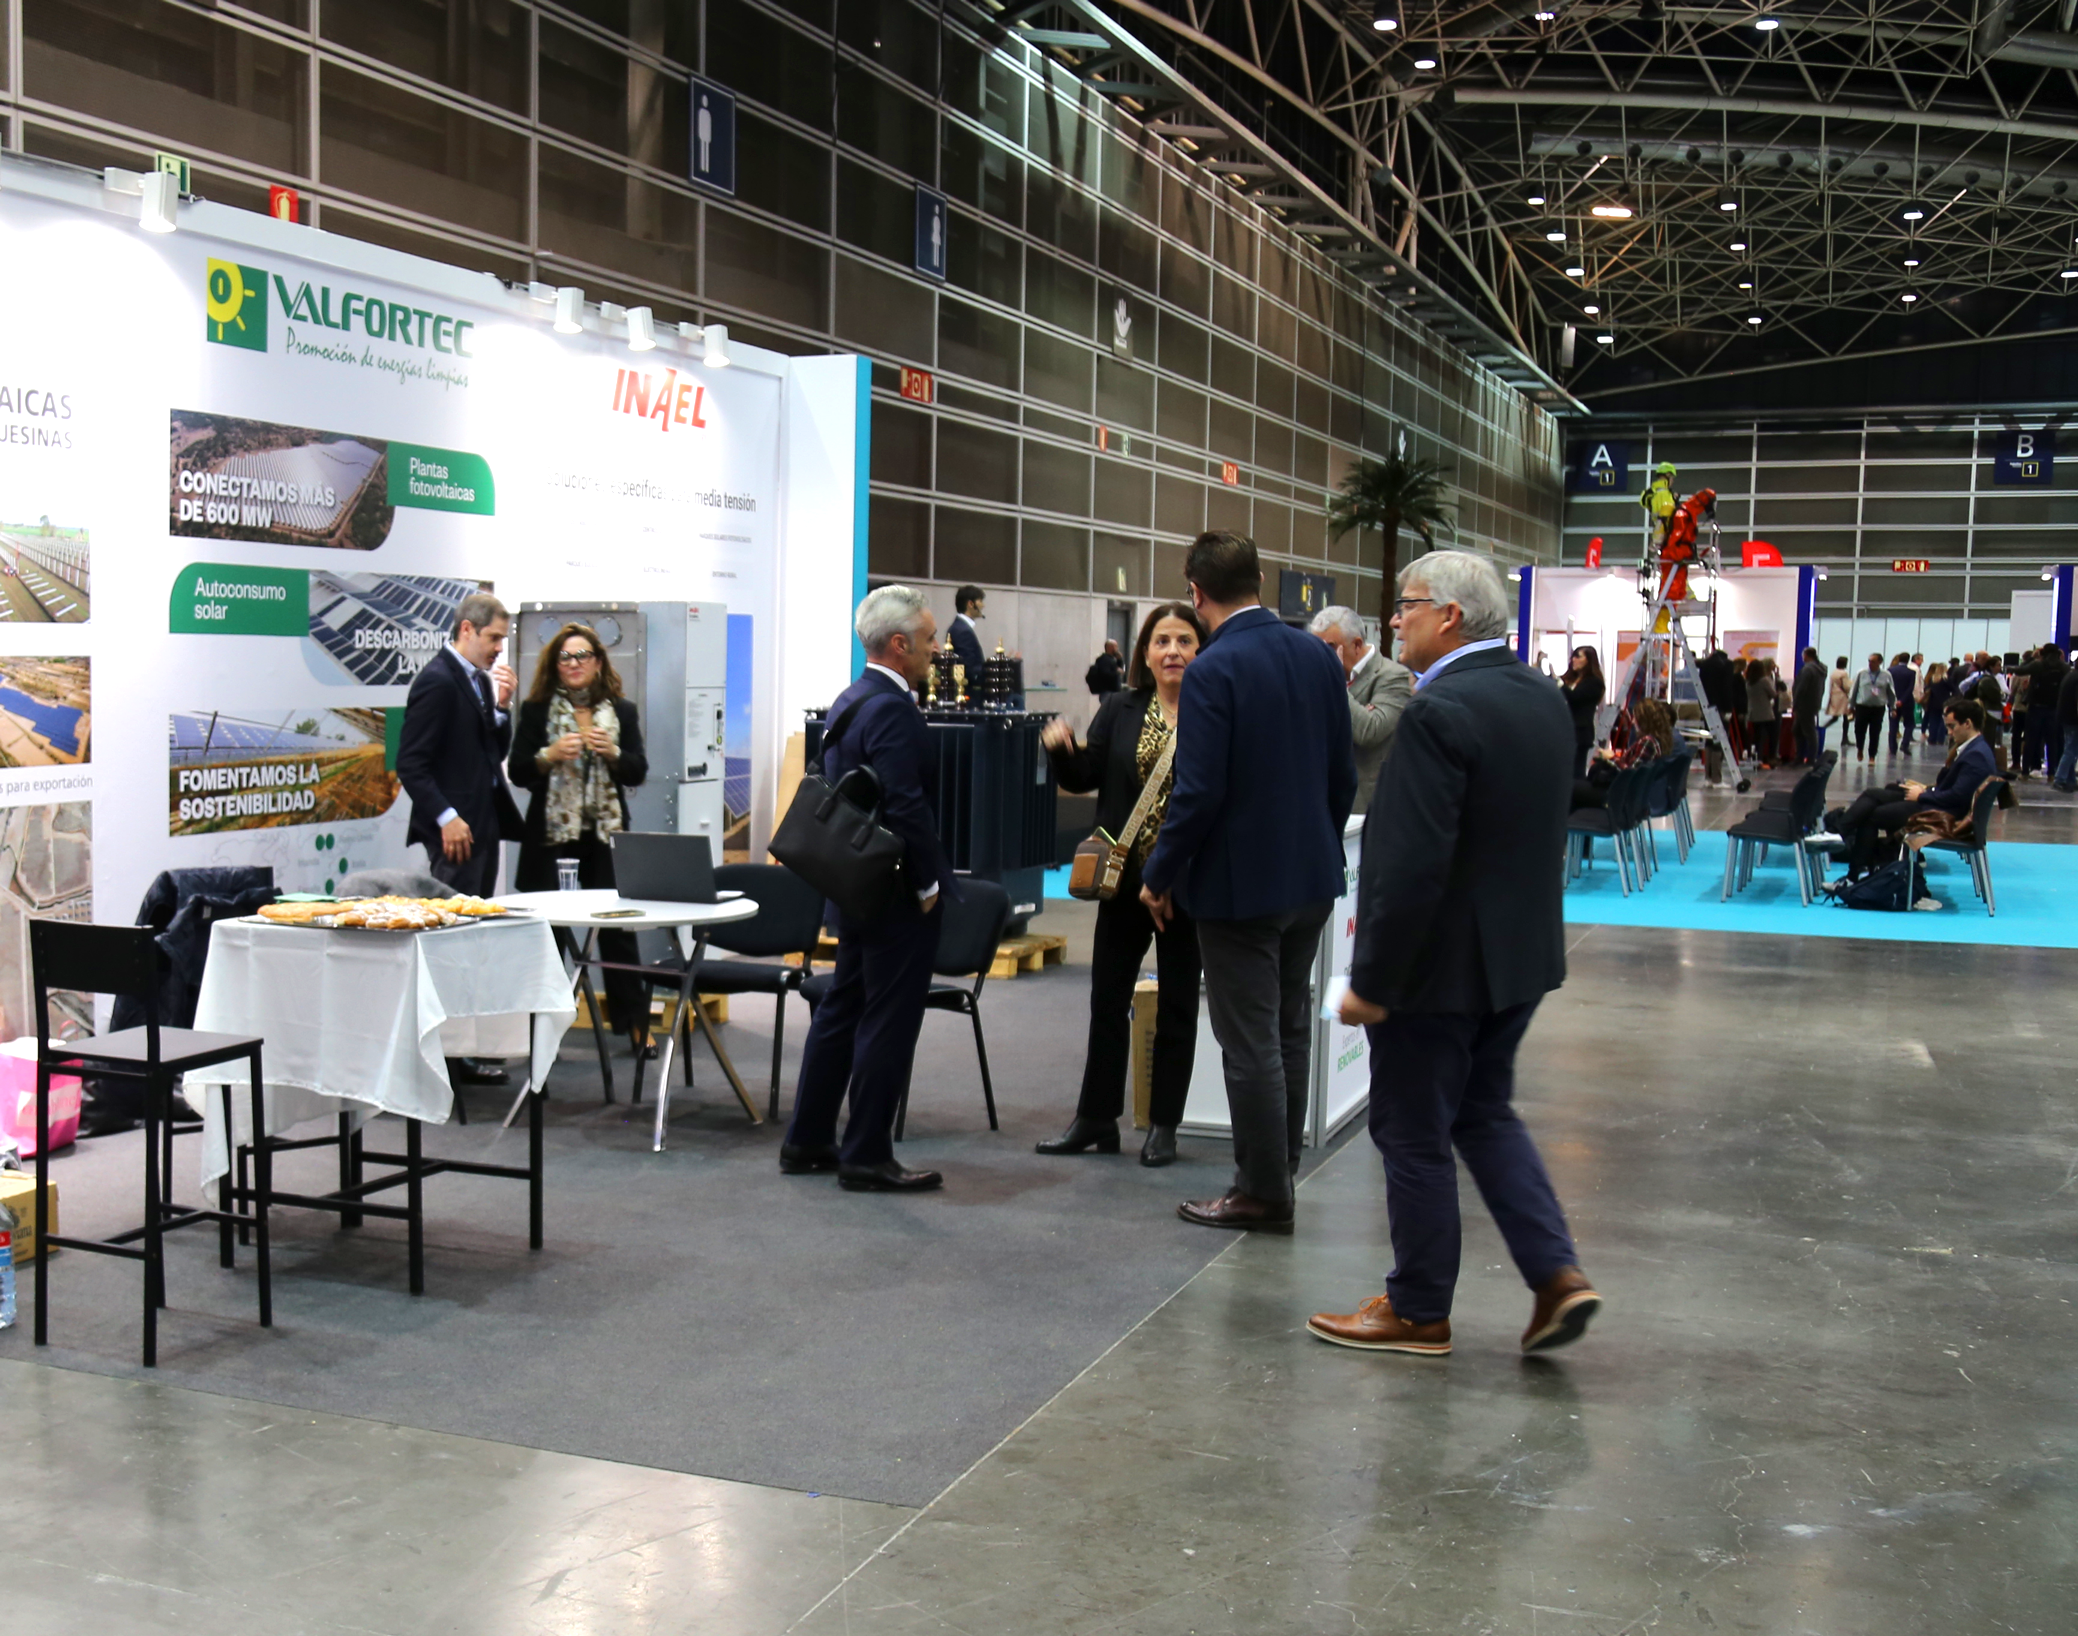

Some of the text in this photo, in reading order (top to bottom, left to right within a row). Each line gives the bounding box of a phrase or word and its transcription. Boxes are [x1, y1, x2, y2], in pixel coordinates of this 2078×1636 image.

[273, 273, 474, 359] VALFORTEC
[286, 326, 357, 363] Promoción
[360, 346, 374, 367] de
[425, 357, 469, 391] limpias
[612, 367, 706, 432] INAEL
[1591, 444, 1613, 467] A
[2016, 434, 2034, 458] B
[410, 457, 448, 479] Plantas
[2027, 464, 2033, 474] 1
[179, 469, 335, 508] CONECTAMOS MÁS
[409, 477, 475, 502] fotovoltaicas
[694, 488, 722, 509] media
[723, 491, 757, 512] tensión
[179, 499, 273, 528] DE 600 MW
[194, 577, 286, 601] Autoconsumo
[194, 600, 228, 620] solar
[398, 655, 417, 674] LA
[7, 780, 30, 796] para
[33, 775, 93, 793] exportación
[179, 763, 320, 792] FOMENTAMOS LA
[179, 790, 316, 821] SOSTENIBILIDAD
